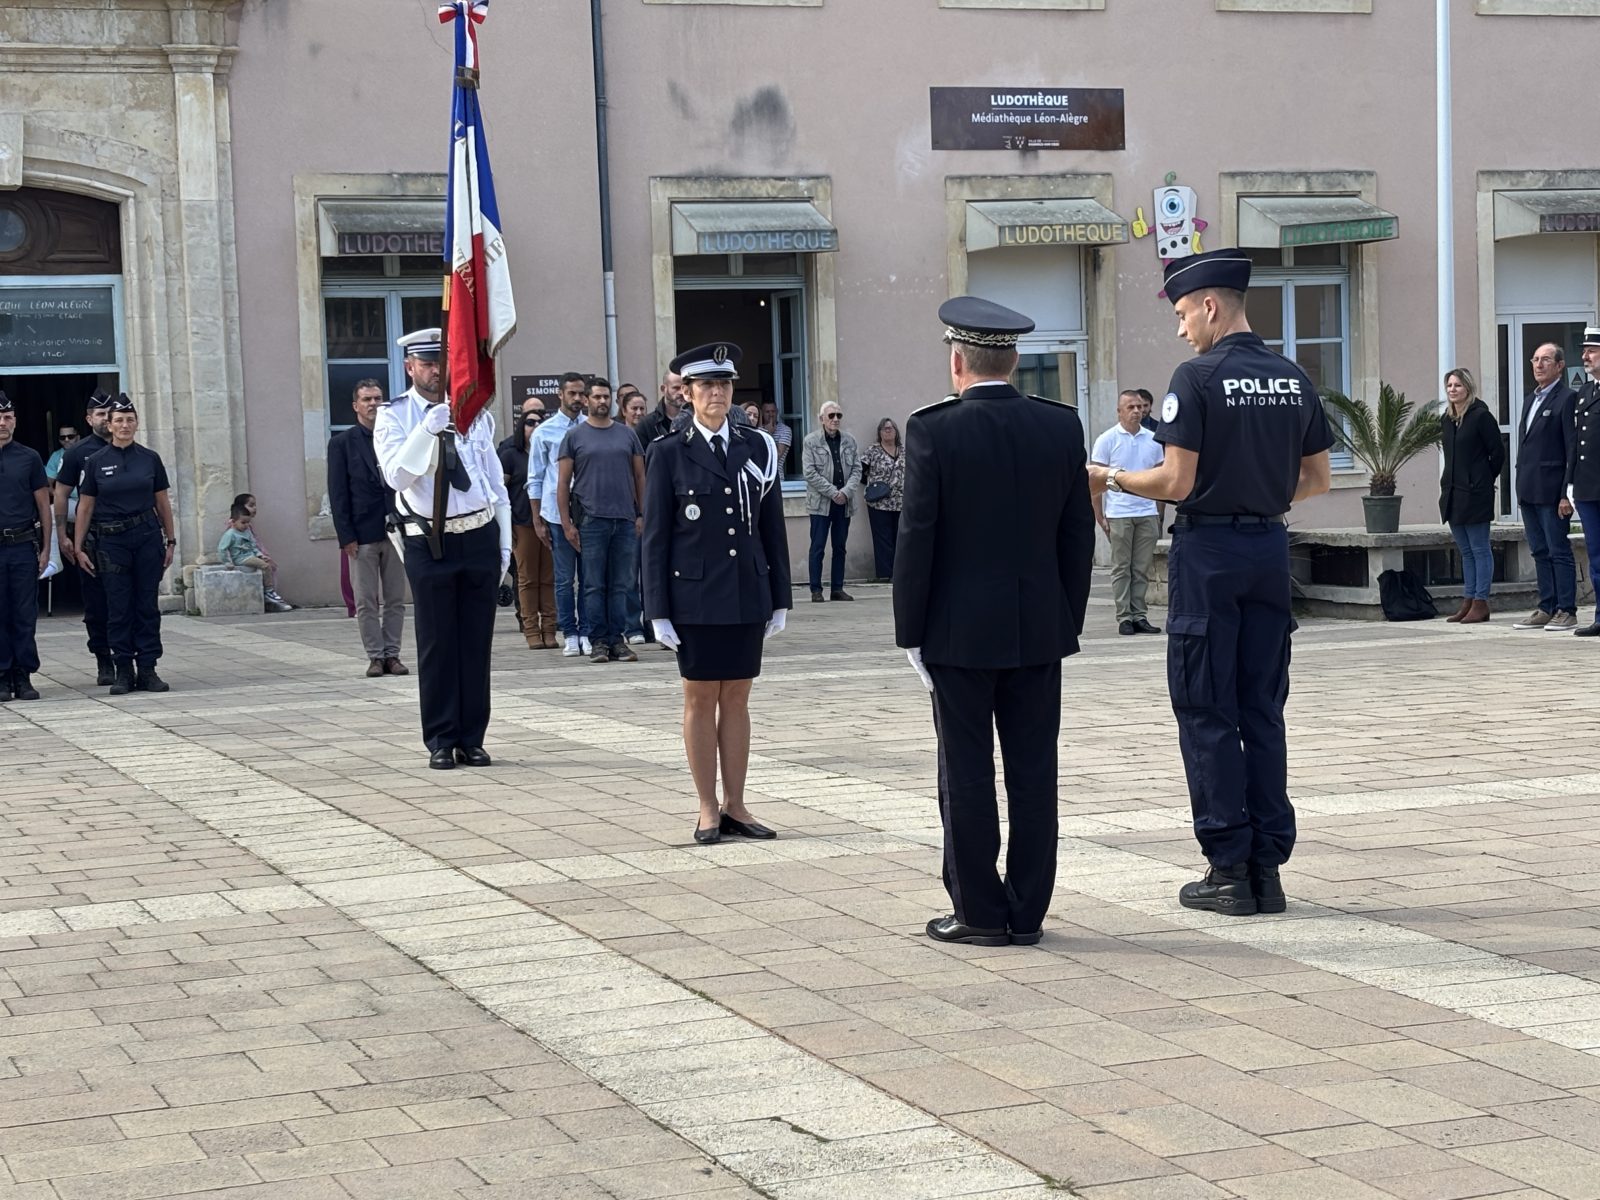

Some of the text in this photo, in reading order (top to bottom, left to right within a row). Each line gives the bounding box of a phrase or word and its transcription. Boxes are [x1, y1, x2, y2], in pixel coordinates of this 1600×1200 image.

[990, 92, 1069, 107] LUDOTHÈQUE
[971, 112, 1088, 125] Médiathèque Léon-Alègre
[704, 232, 832, 251] LUDOTHEQUE
[1005, 224, 1123, 244] LUDOTHEQUE
[344, 234, 441, 254] LUDOTHE
[539, 379, 560, 387] ESPA
[1222, 378, 1301, 396] POLICE
[526, 387, 560, 396] SIMONE
[1226, 396, 1303, 408] NATIONALE
